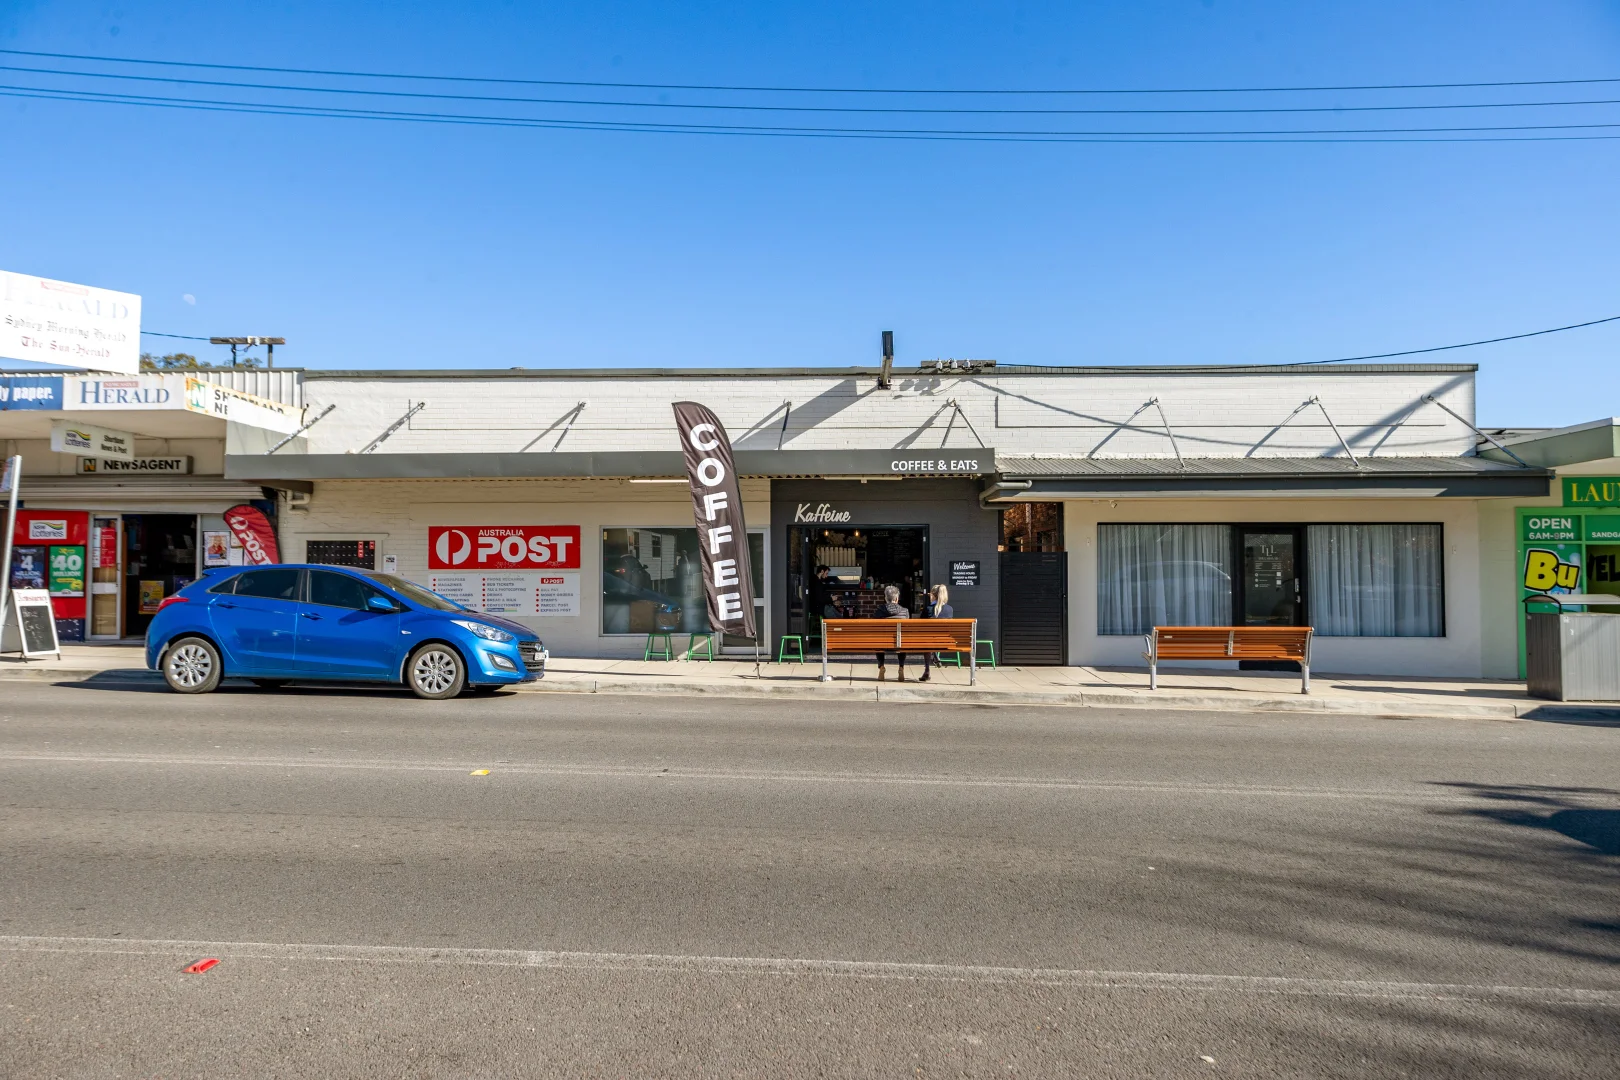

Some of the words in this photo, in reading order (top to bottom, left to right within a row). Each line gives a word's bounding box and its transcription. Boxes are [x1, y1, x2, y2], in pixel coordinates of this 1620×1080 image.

[5, 315, 42, 331] Sydney
[21, 336, 43, 348] The
[12, 386, 54, 402] paper.
[80, 381, 170, 404] HERALD
[65, 438, 91, 449] Lotteries
[104, 460, 182, 470] NEWSAGENT
[891, 460, 934, 470] COFFEE
[937, 460, 948, 470] &
[950, 460, 978, 470] EATS
[1571, 483, 1620, 502] LAU
[794, 503, 851, 522] Kaffeine
[690, 424, 744, 621] COFFEE
[1528, 518, 1572, 530] OPEN
[239, 530, 273, 564] POST
[478, 536, 573, 562] POST
[50, 554, 82, 571] $40
[1525, 550, 1580, 592] Bu
